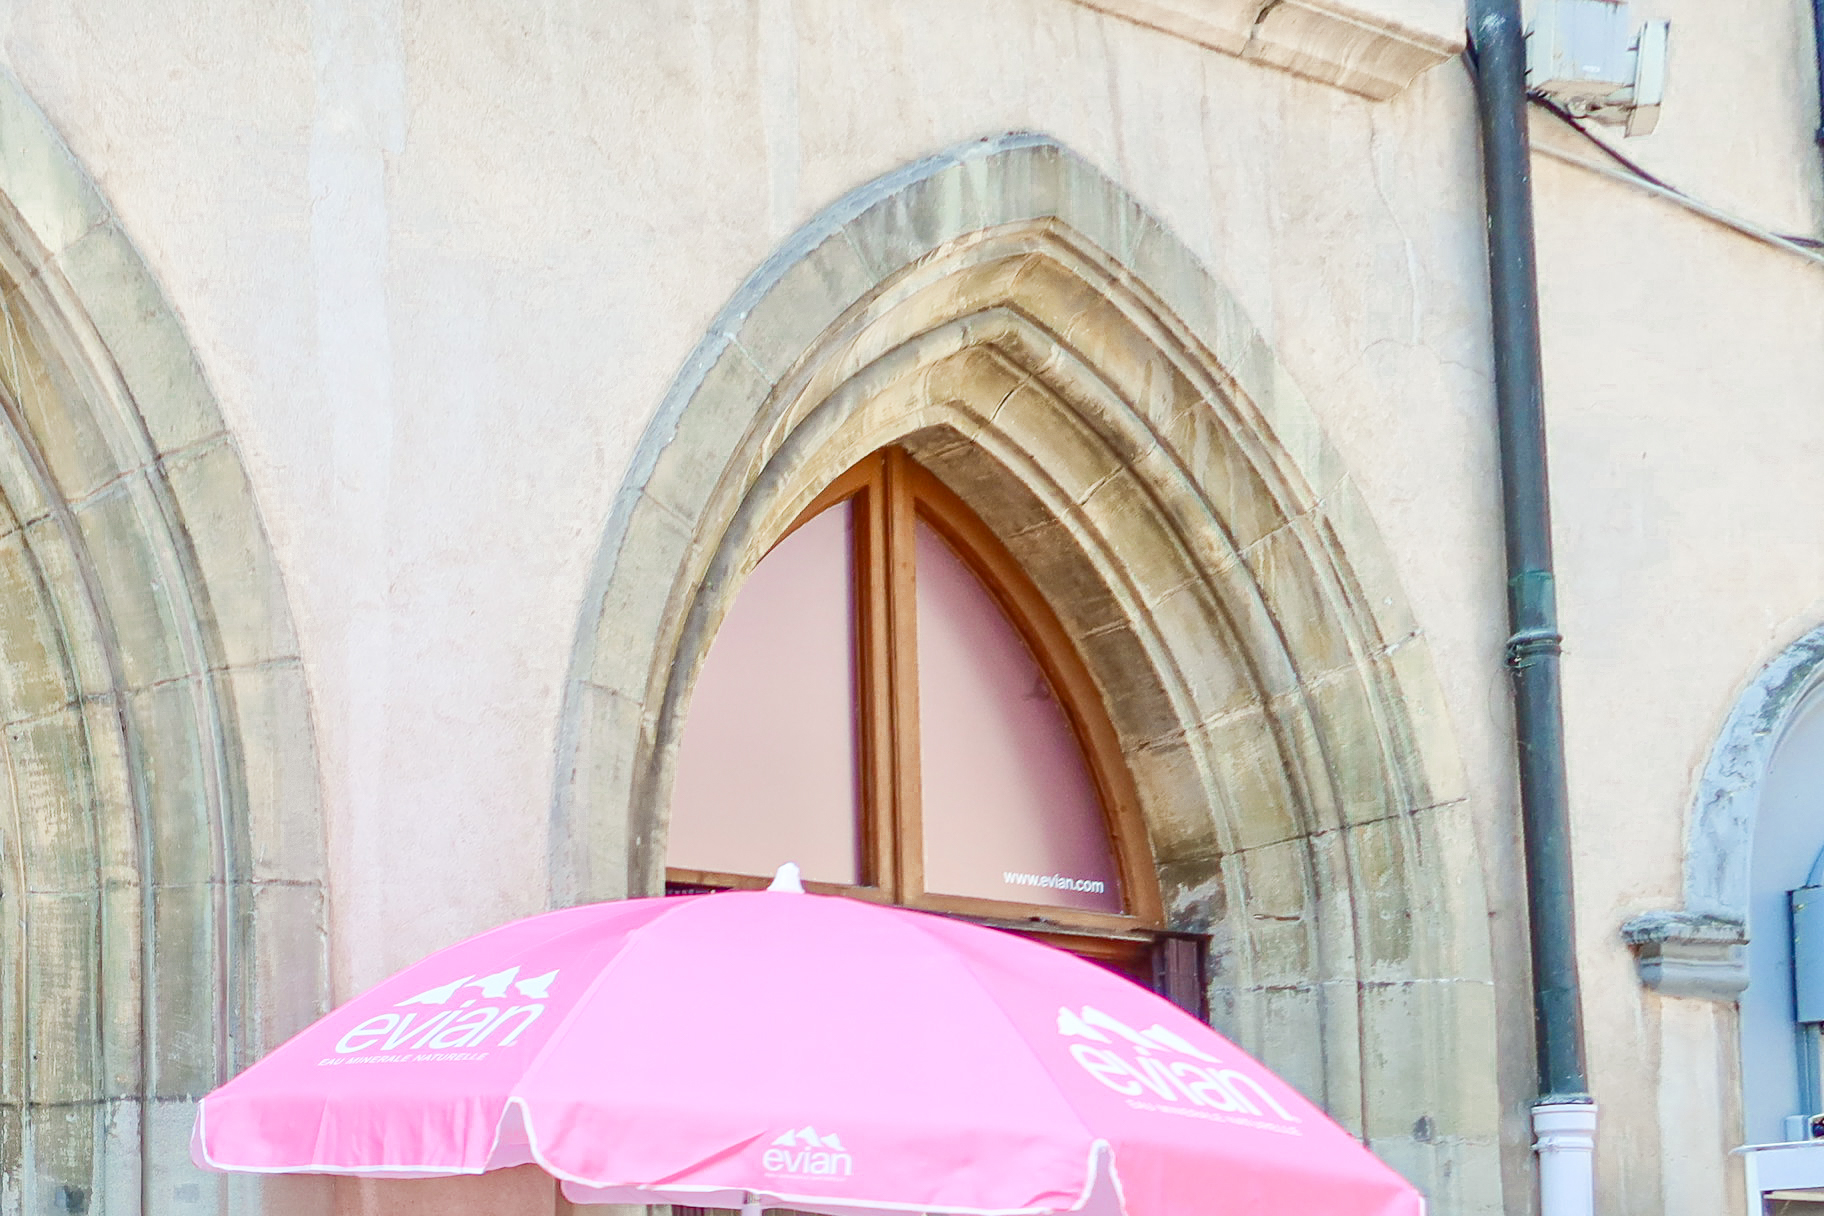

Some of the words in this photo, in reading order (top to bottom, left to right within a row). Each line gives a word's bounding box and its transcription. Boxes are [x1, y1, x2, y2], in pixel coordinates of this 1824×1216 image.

[1003, 871, 1104, 893] www.evian.com
[334, 999, 545, 1054] evian
[318, 1057, 345, 1066] EAU
[411, 1052, 490, 1062] NATURELLE
[1069, 1043, 1303, 1124] evian
[762, 1146, 853, 1176] evian
